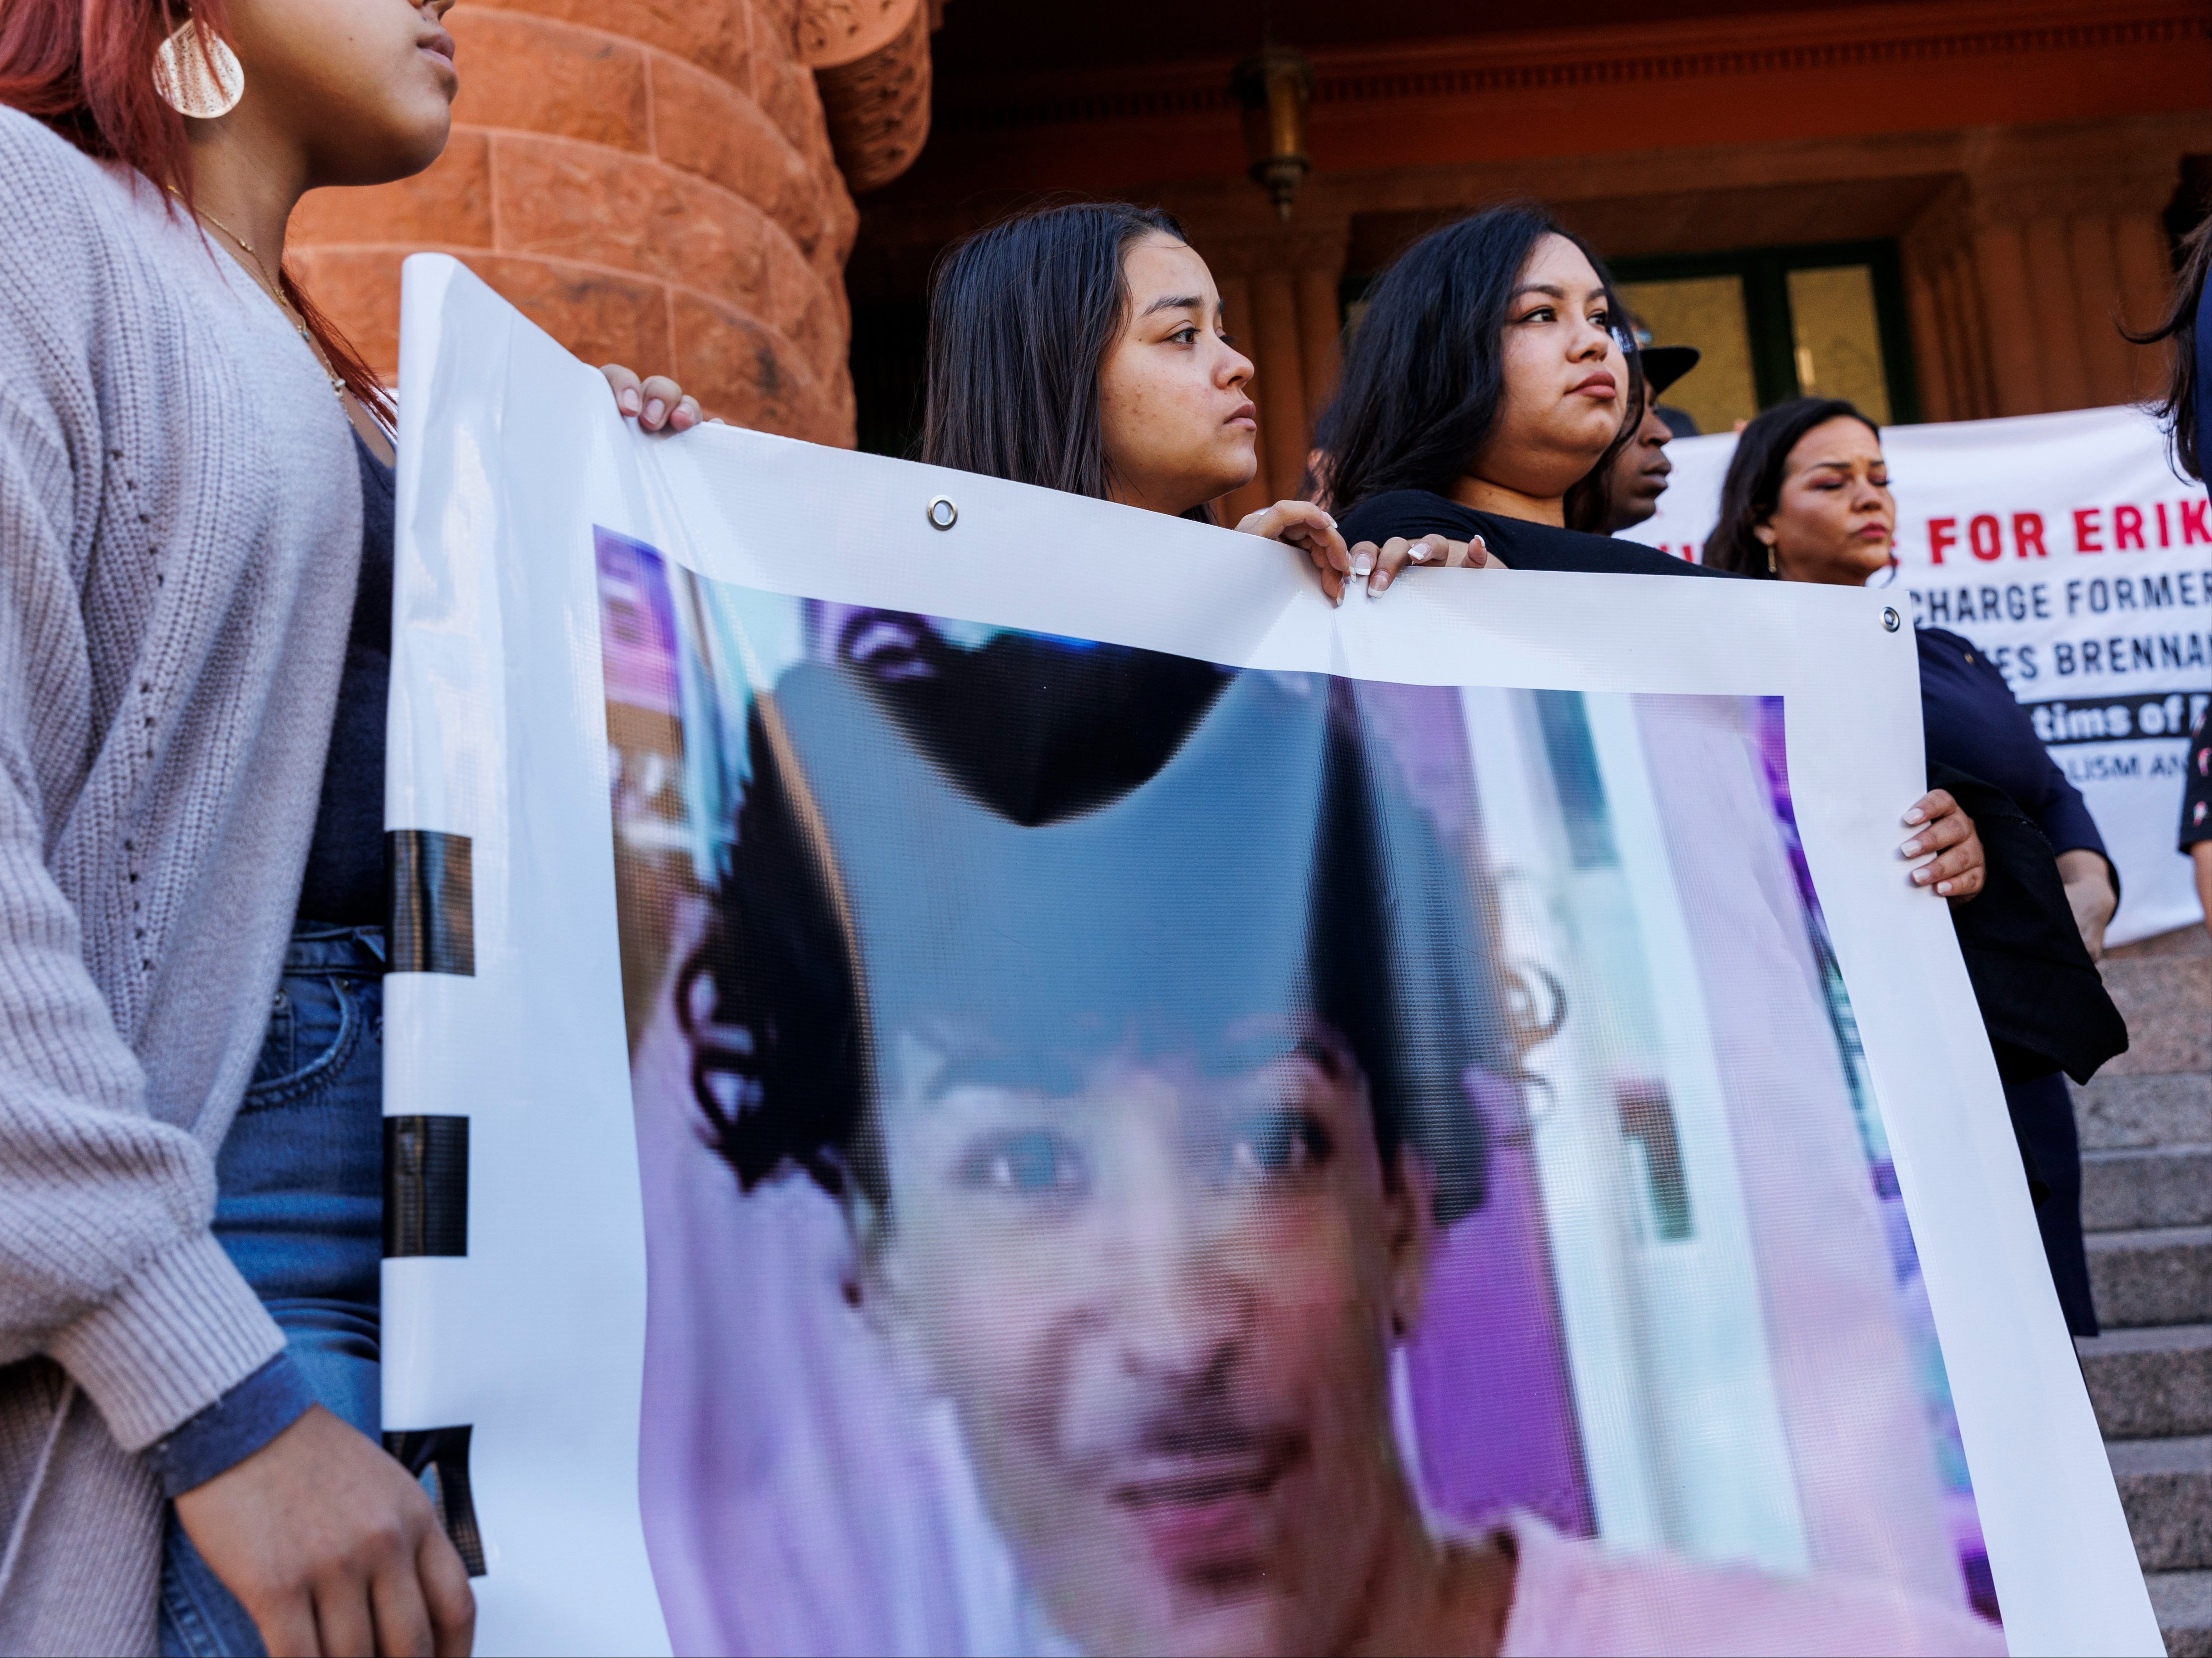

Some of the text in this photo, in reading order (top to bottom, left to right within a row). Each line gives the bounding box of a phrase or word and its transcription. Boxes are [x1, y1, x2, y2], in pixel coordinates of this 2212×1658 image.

[1928, 512, 2048, 564] FOR
[2073, 498, 2212, 552] ERIK
[1985, 633, 2212, 680] ES BRENNA
[2138, 694, 2184, 736] of
